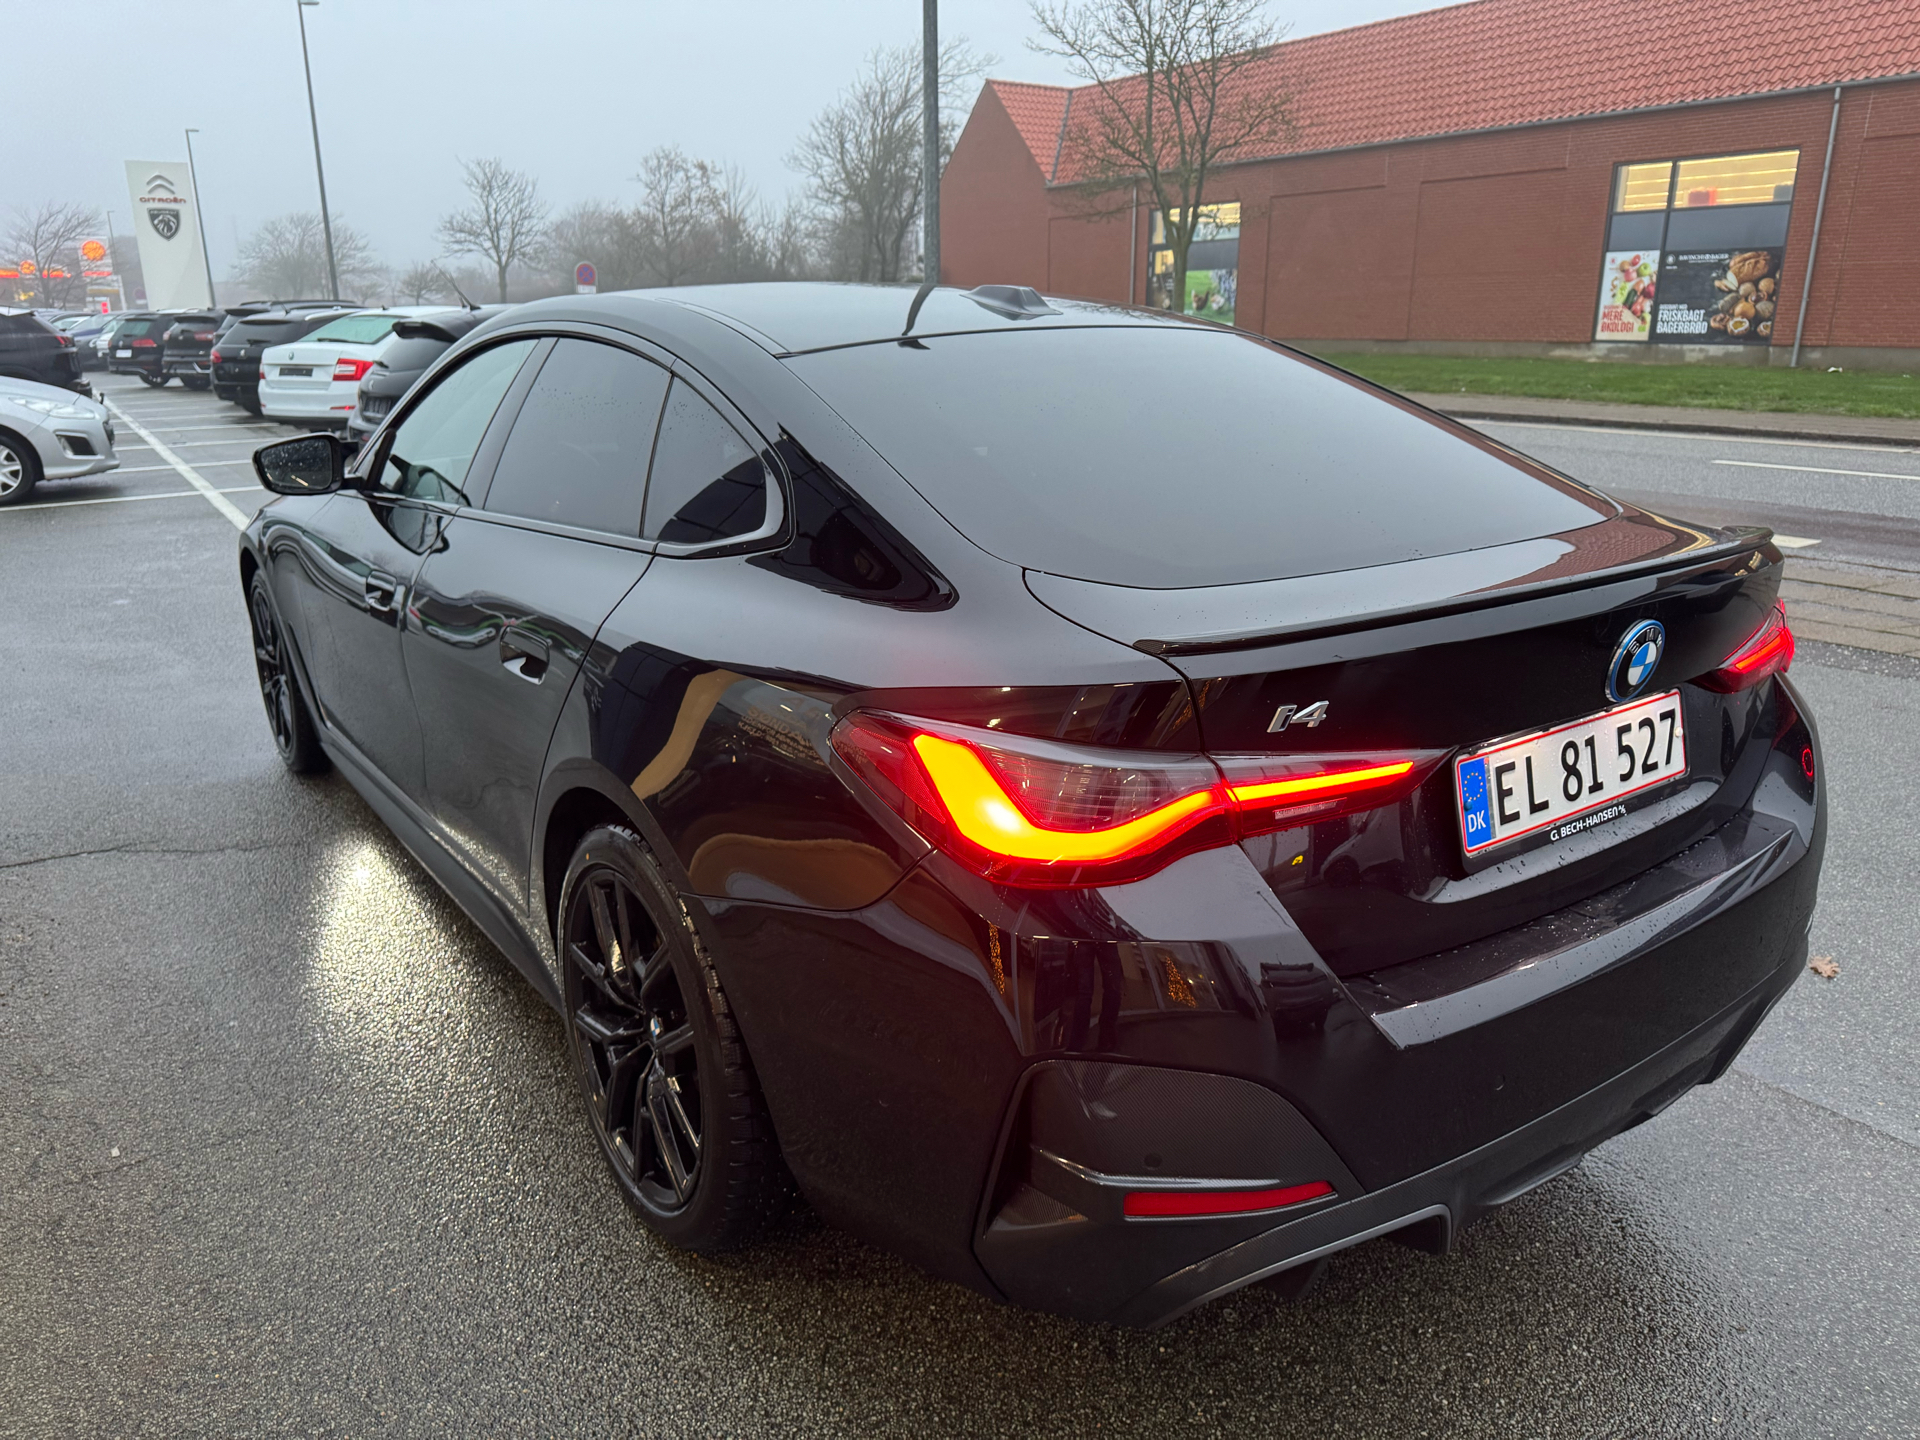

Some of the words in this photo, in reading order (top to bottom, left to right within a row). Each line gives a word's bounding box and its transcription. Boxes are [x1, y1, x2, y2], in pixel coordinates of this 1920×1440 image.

[1602, 310, 1623, 321] MERE
[1658, 309, 1706, 321] FRISKBAGT
[1656, 321, 1708, 334] BAGERBRØD
[1266, 700, 1329, 733] i4
[1495, 756, 1549, 826] EL
[1561, 734, 1604, 802] 81
[1616, 708, 1676, 782] 527
[1468, 810, 1487, 833] DK
[1560, 806, 1618, 838] BECH-HANSEN
